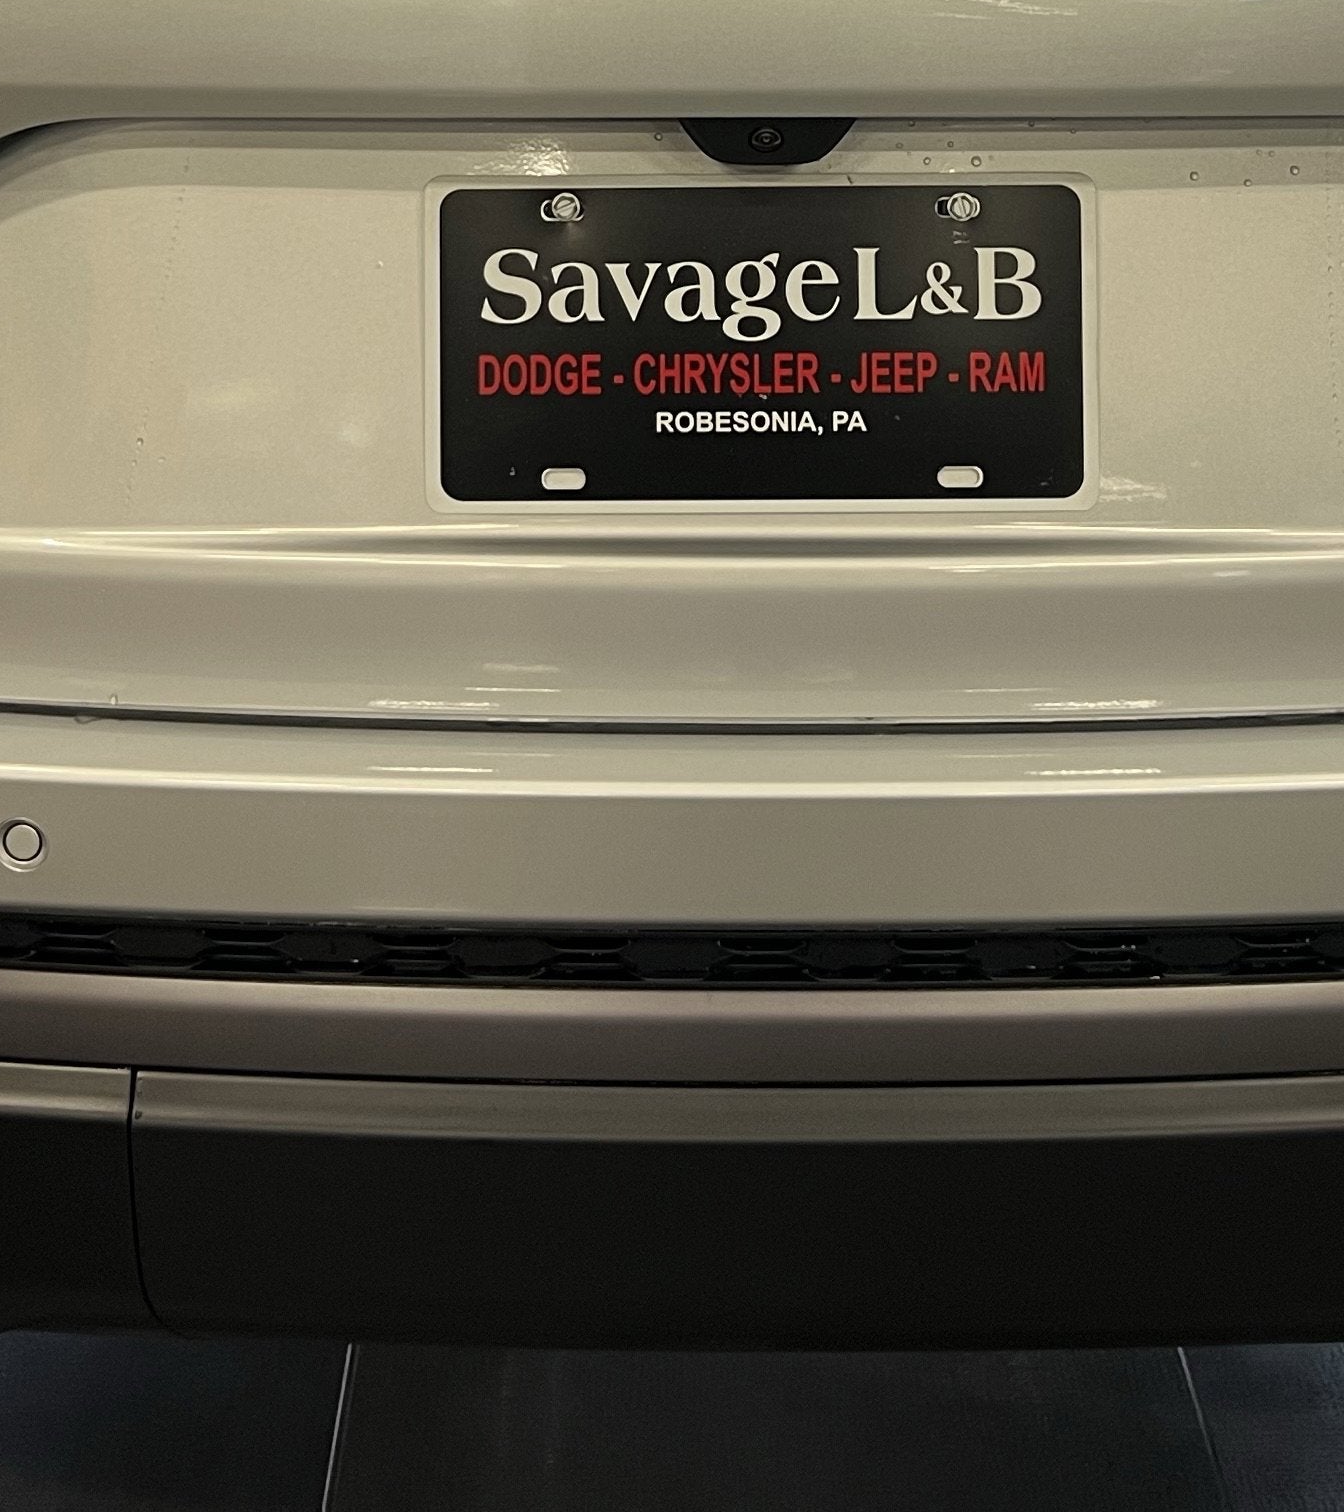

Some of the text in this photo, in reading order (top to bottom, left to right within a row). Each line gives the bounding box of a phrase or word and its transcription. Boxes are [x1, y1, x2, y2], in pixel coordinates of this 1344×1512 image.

[480, 246, 1043, 341] Savage L&B
[477, 353, 603, 396] DODGE
[633, 352, 820, 395] CHRYSLER
[850, 351, 938, 393] JEEP
[969, 351, 1046, 393] RAM
[655, 410, 867, 436] ROBESONIA, PA
